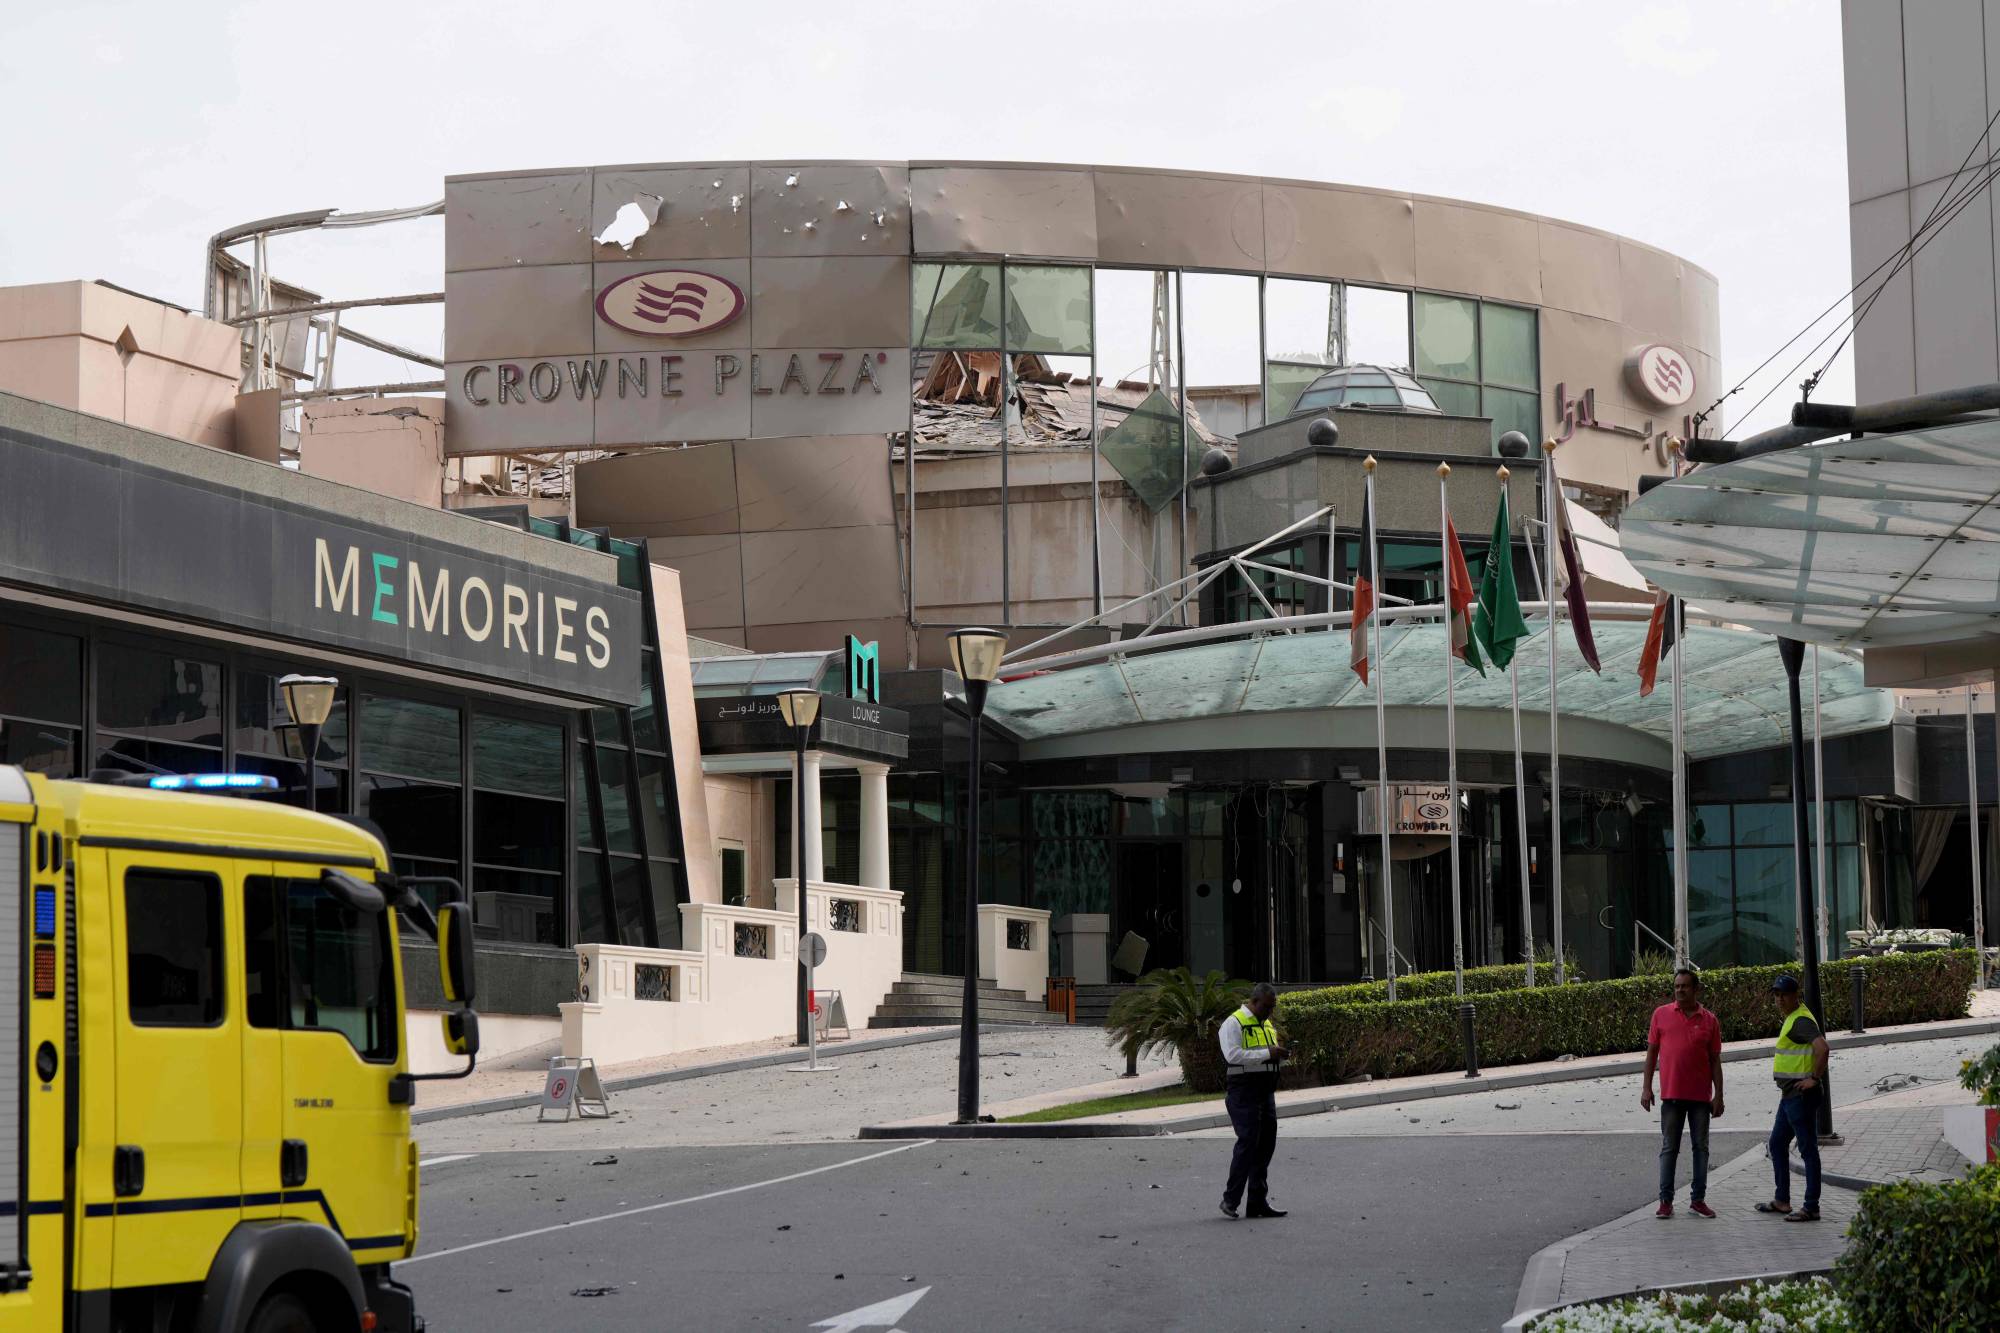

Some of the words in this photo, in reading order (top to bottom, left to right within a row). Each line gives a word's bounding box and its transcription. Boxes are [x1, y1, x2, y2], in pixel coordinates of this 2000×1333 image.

[463, 355, 684, 407] CROWNE
[715, 353, 883, 395] PLAZA
[314, 537, 611, 669] MEMORIES
[852, 705, 880, 724] LOUNGE
